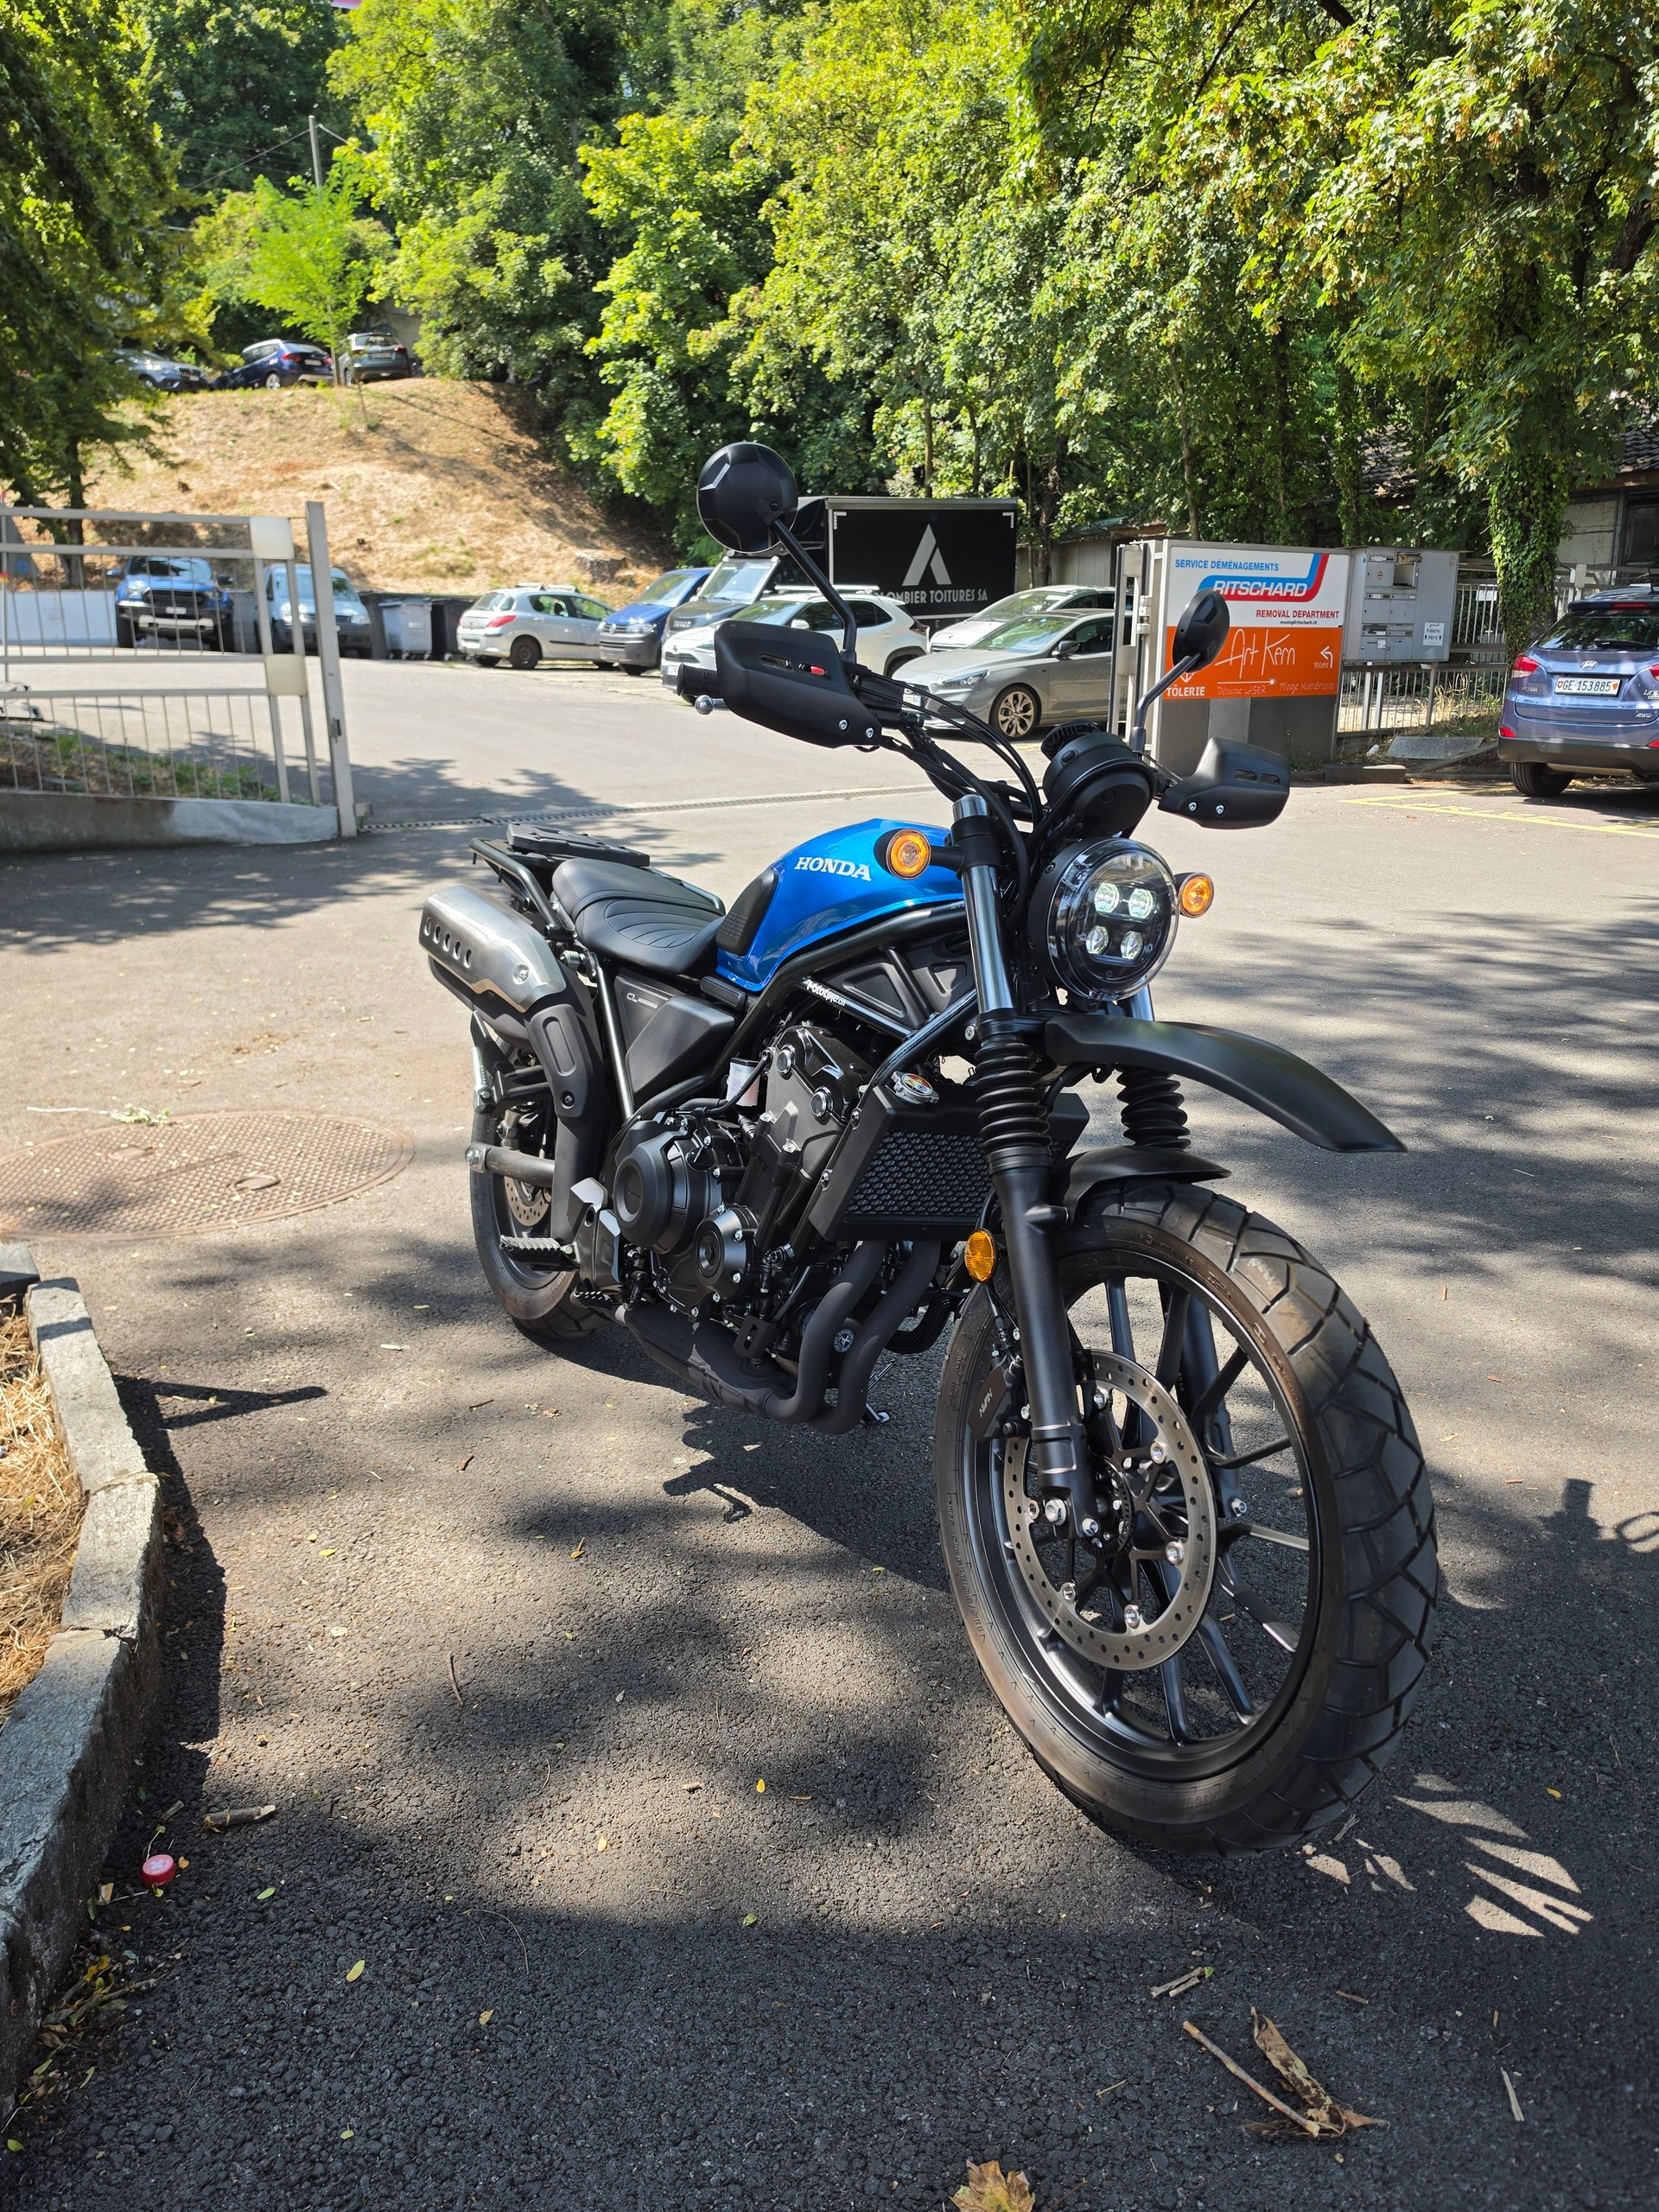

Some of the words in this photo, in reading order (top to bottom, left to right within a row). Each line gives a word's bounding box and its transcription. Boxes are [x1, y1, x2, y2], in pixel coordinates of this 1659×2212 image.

[1175, 559, 1208, 569] SERVICE
[1211, 559, 1279, 571] DÉMÉNAGEMENTS
[1212, 580, 1307, 596] RITSCHARD
[930, 589, 975, 603] TOITURES
[977, 588, 988, 601] SA
[1293, 610, 1339, 619] DEPARTMENT
[1166, 685, 1205, 696] TÔLERIE
[794, 856, 872, 881] HONDA
